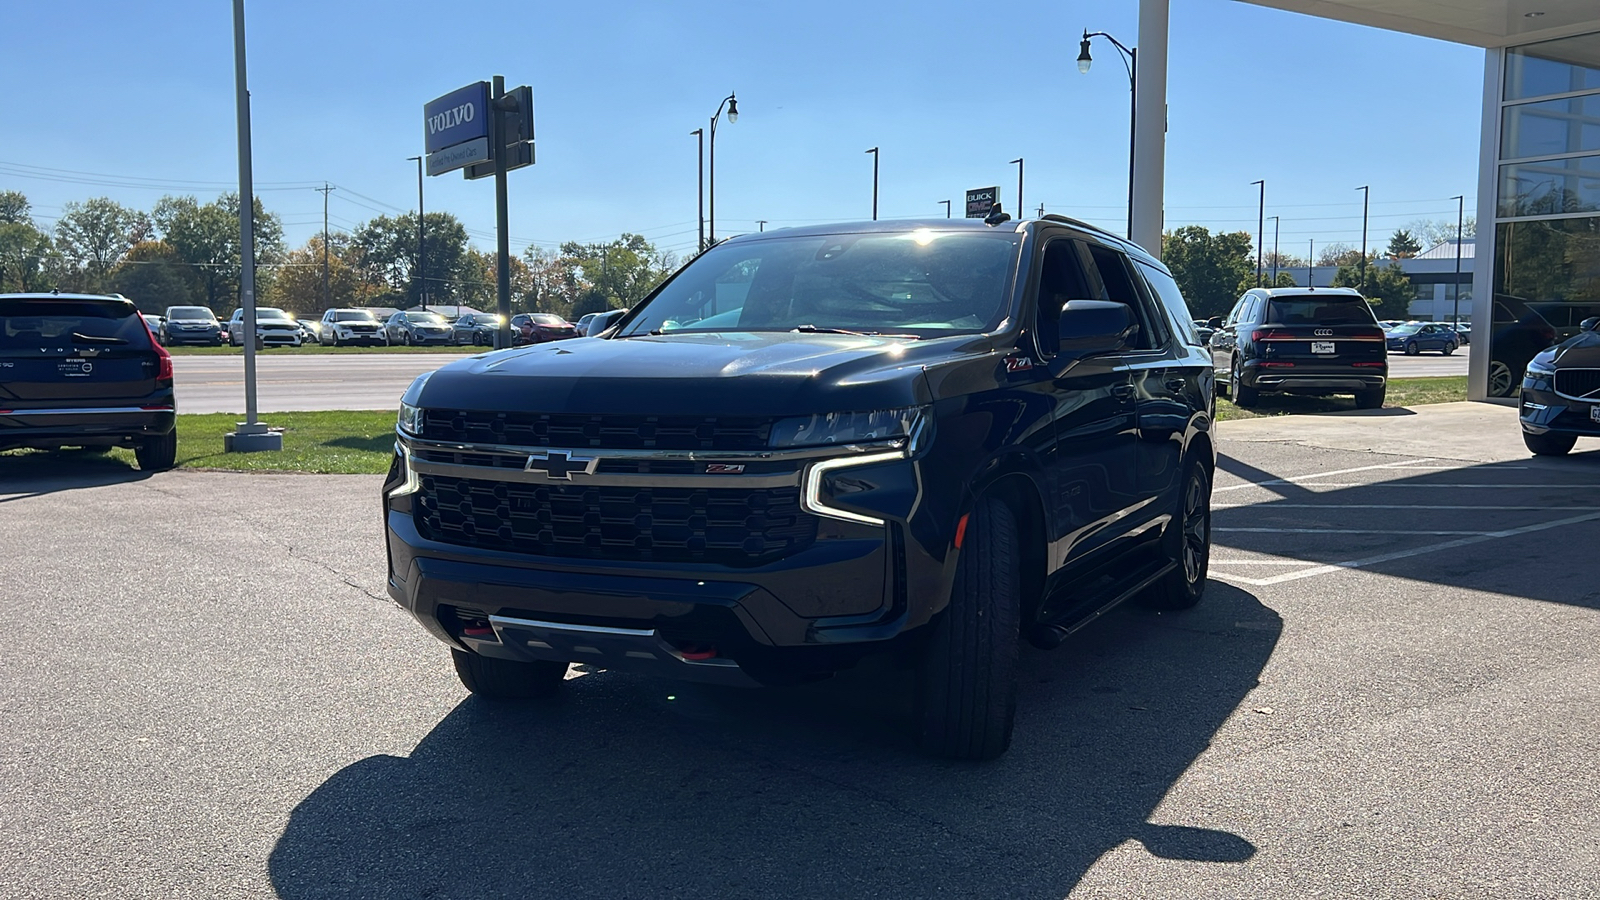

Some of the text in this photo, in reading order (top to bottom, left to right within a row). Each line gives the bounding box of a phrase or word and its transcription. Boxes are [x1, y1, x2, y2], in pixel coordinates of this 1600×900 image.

[428, 102, 475, 135] VOLVO
[967, 192, 992, 202] BUICK
[968, 199, 991, 213] GMC
[706, 463, 746, 473] Z71
